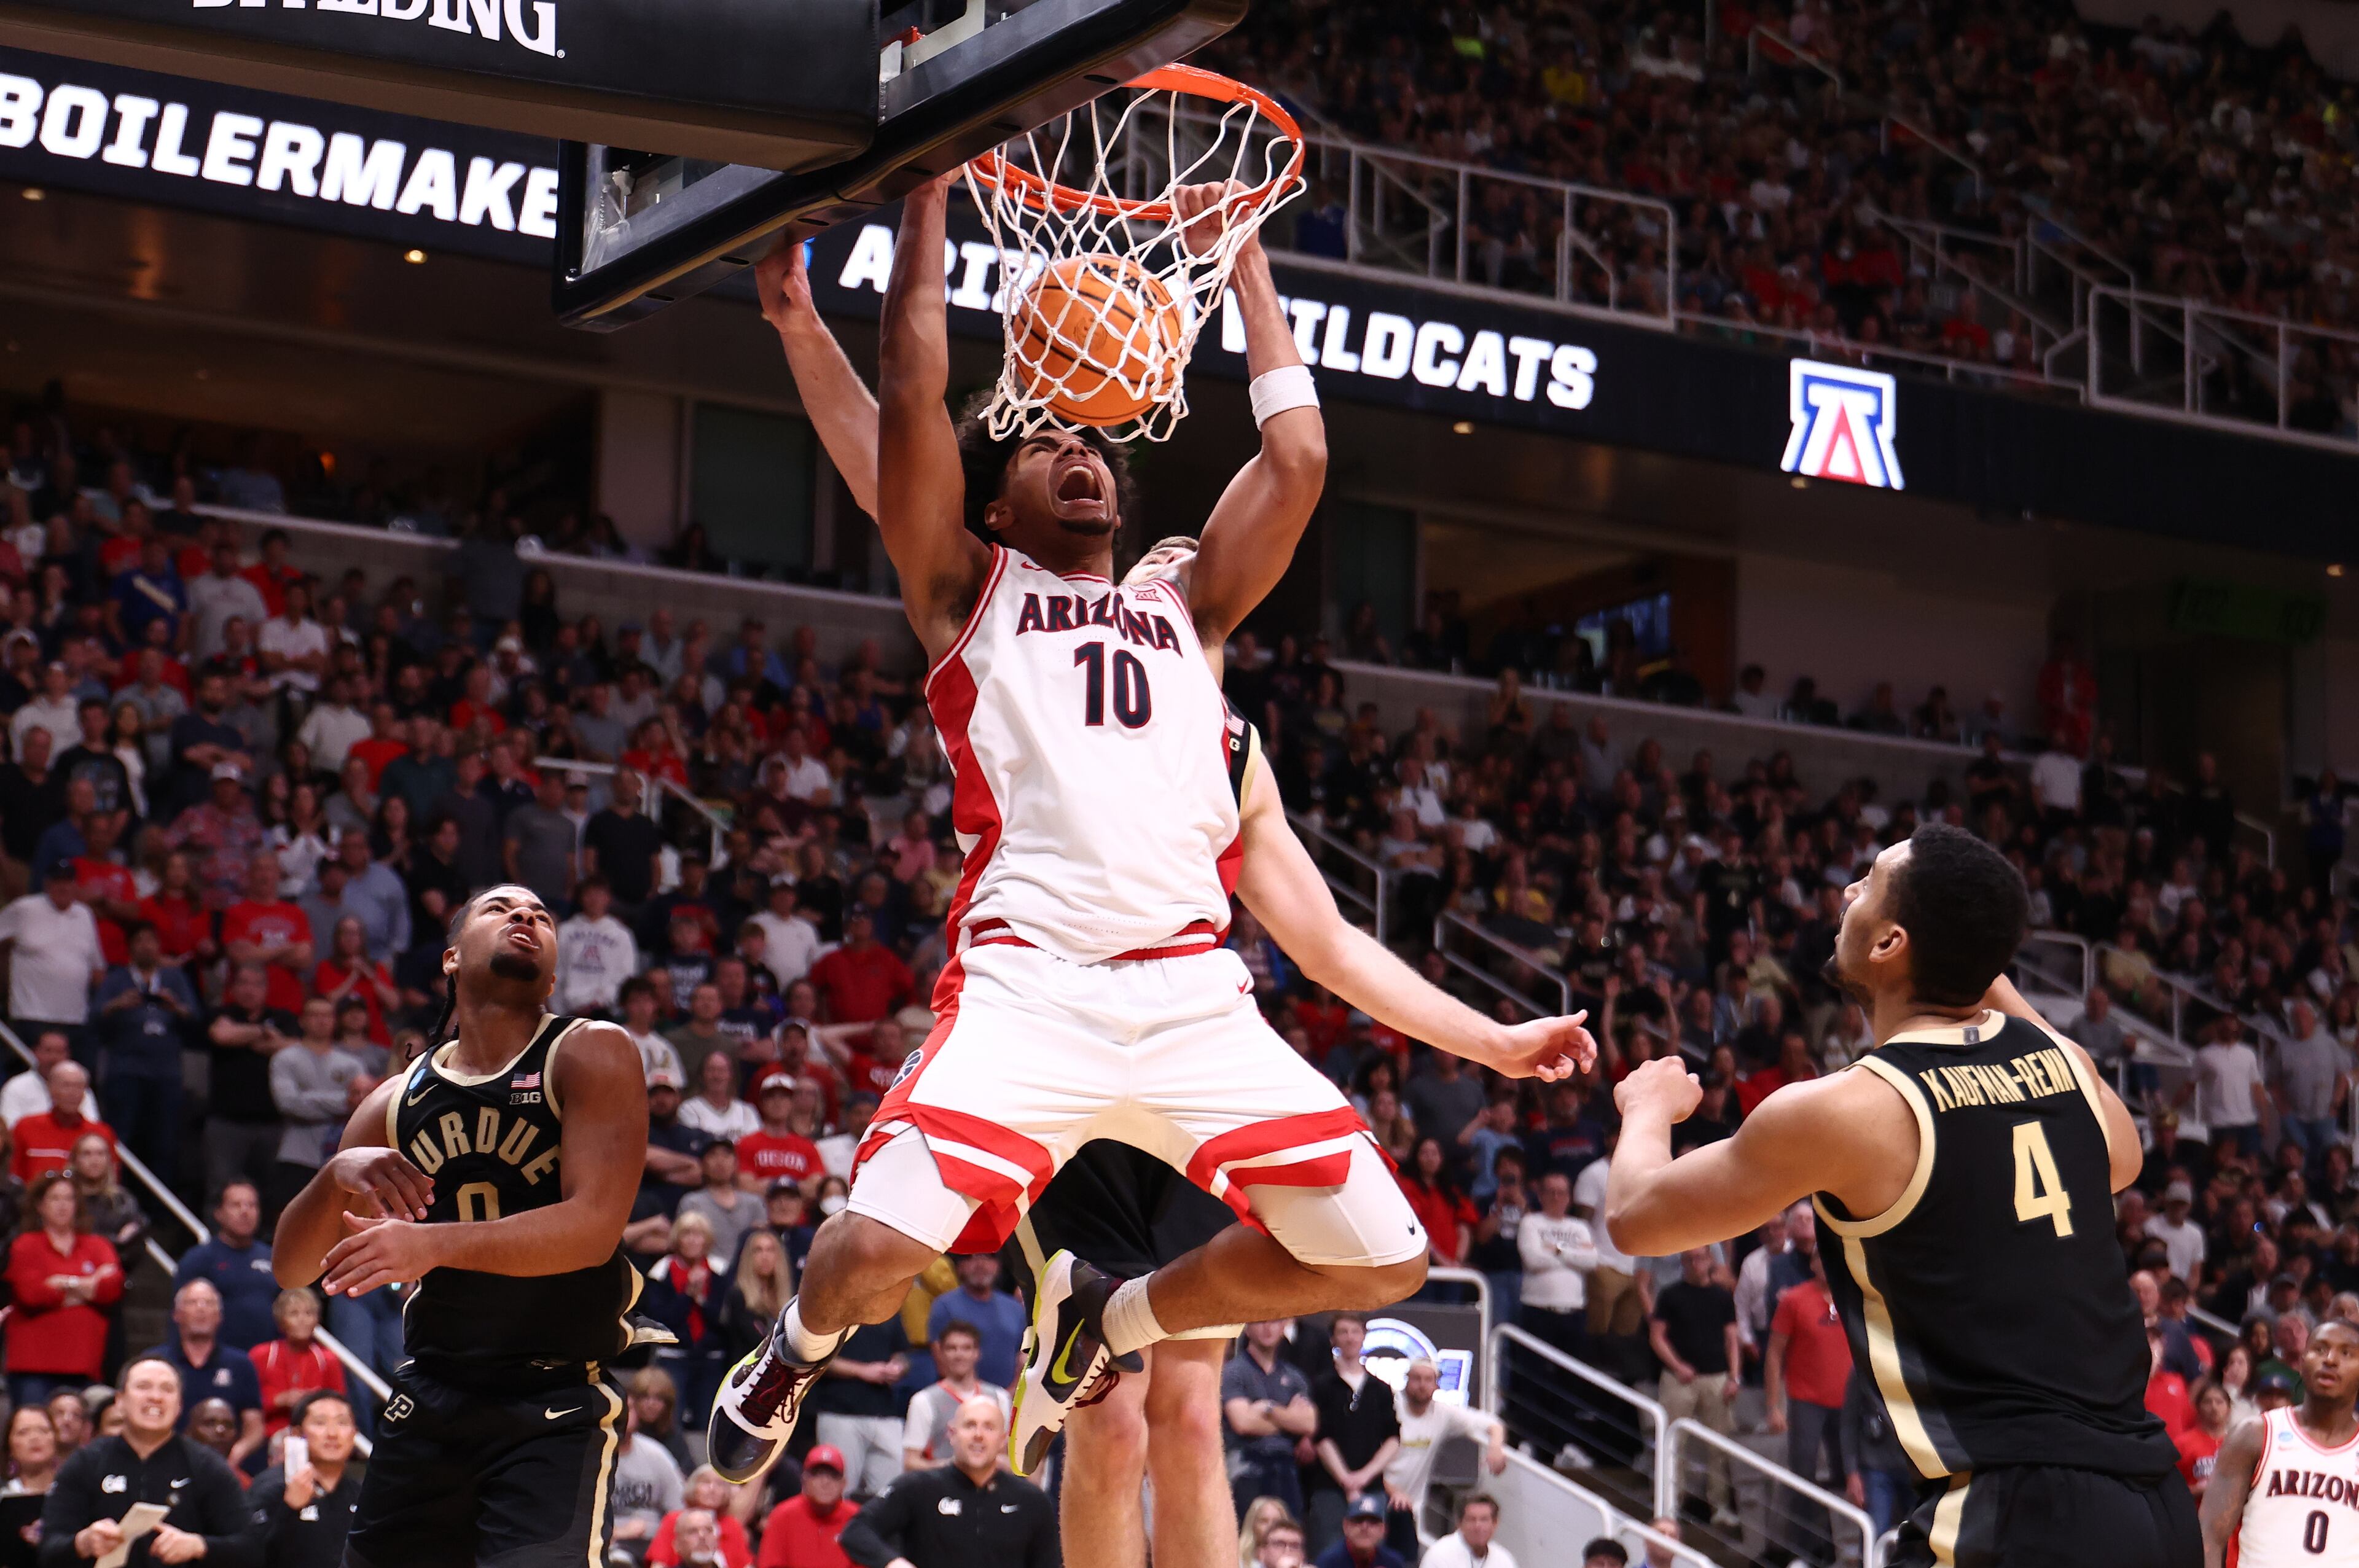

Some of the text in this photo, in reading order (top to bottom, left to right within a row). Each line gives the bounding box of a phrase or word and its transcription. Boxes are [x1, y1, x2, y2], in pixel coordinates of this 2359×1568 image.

[1015, 591, 1184, 659] ARIZONA
[1074, 641, 1152, 729] 10
[409, 1106, 561, 1186] URDUE
[2012, 1120, 2075, 1238] 4
[383, 1393, 414, 1422] P
[2303, 1510, 2330, 1554] 0
